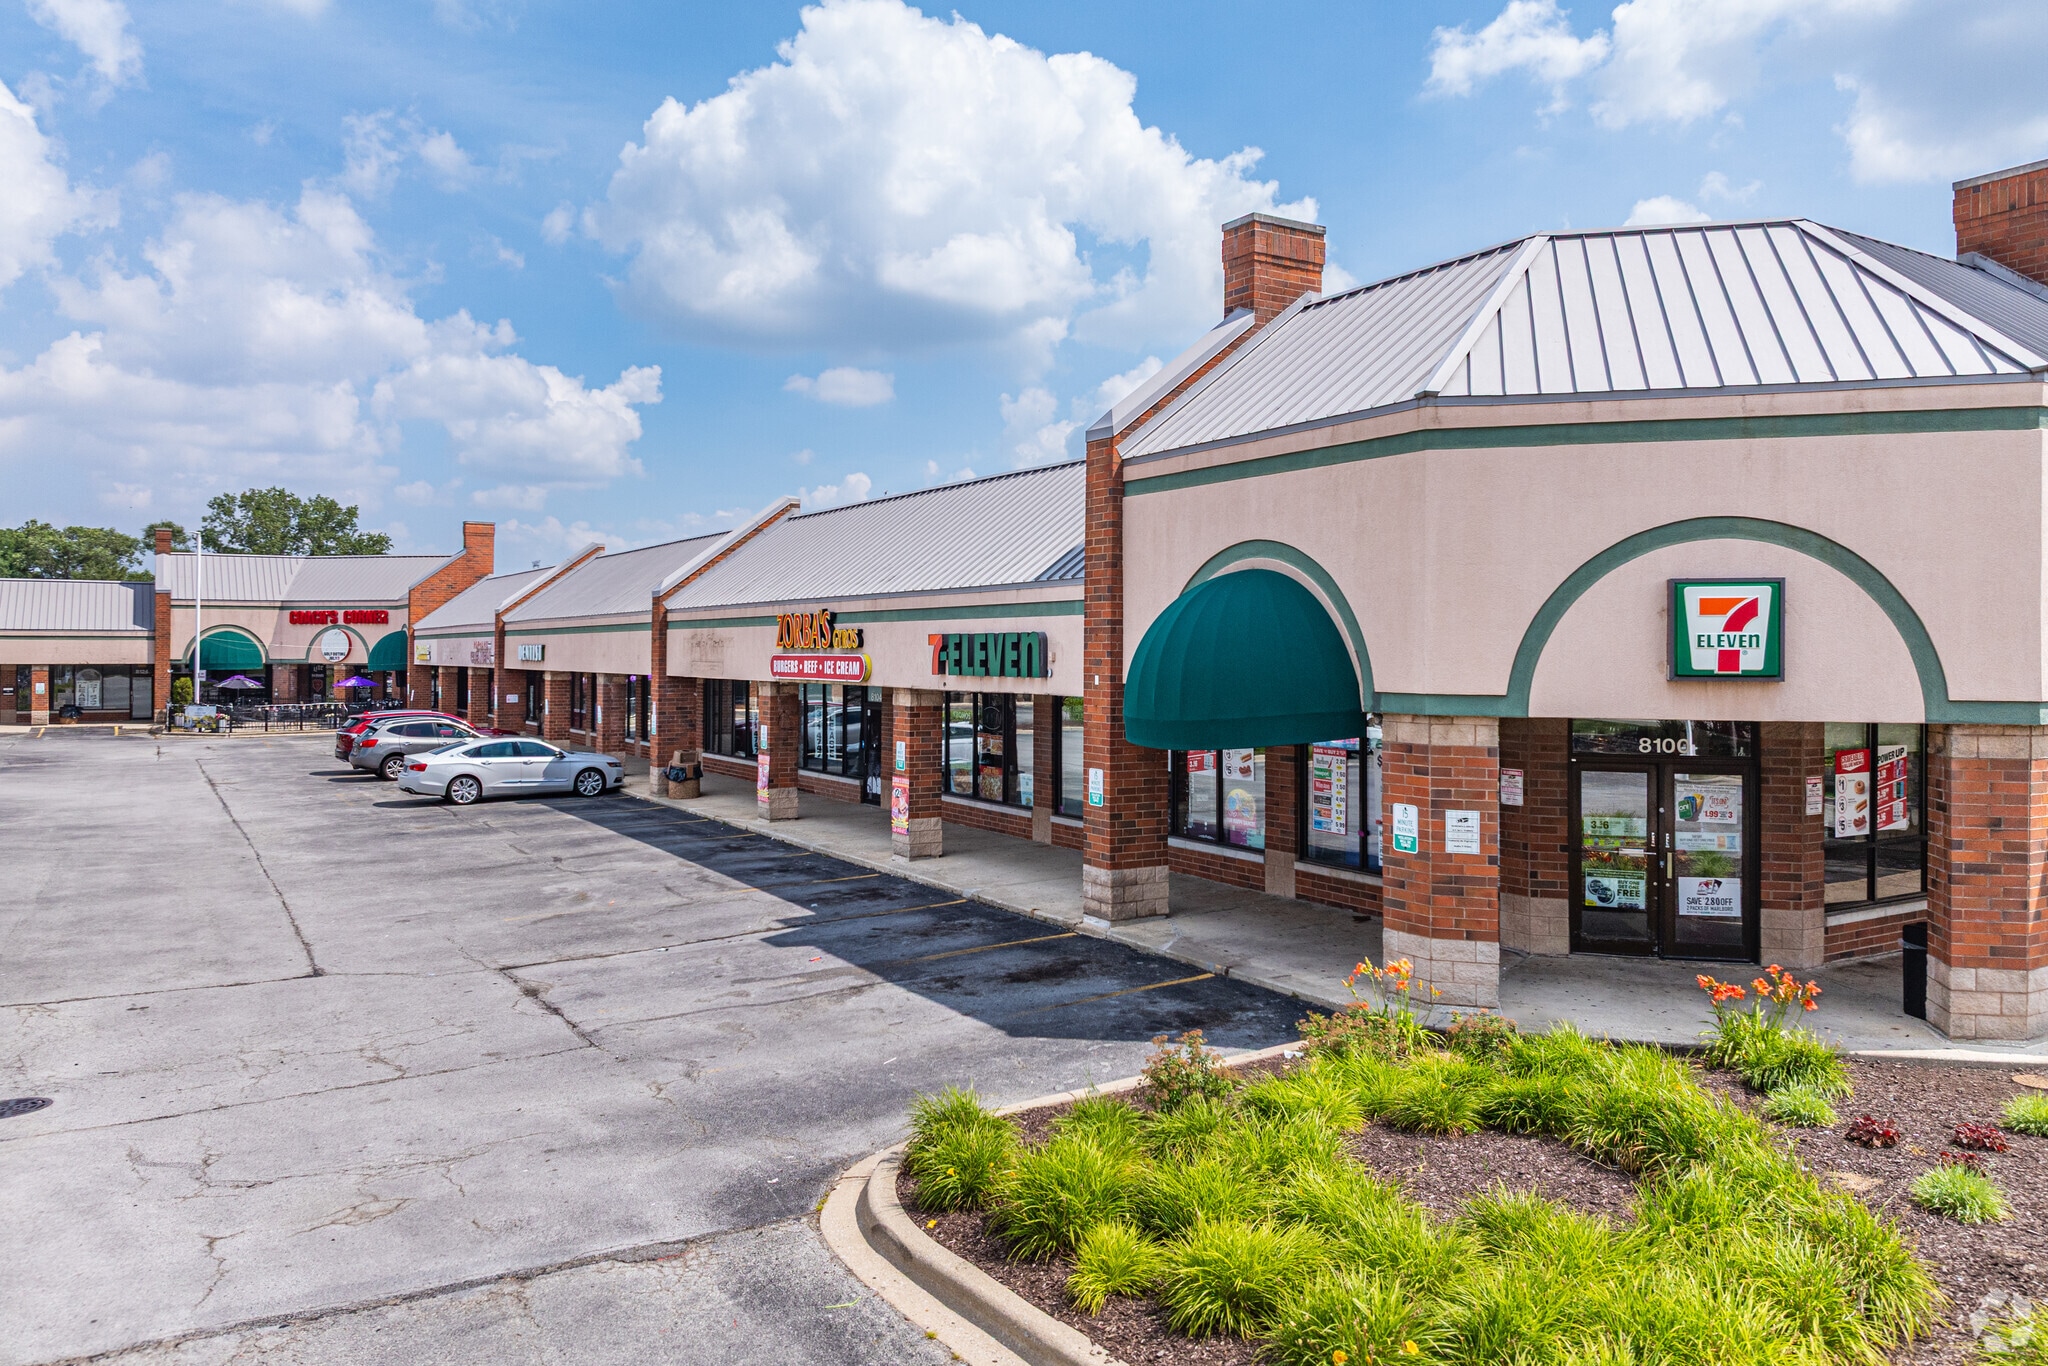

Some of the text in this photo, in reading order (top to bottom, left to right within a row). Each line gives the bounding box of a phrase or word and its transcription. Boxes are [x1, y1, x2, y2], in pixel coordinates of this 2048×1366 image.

[289, 610, 389, 625] COACH'S CORNER
[776, 609, 858, 649] ZORBA'S GYROS
[773, 659, 860, 675] BURGERS BEEF ICE CREAM
[1638, 737, 1690, 754] 8100
[1895, 748, 1904, 757] UP
[1617, 889, 1640, 897] FREE
[1687, 897, 1702, 905] SAVE
